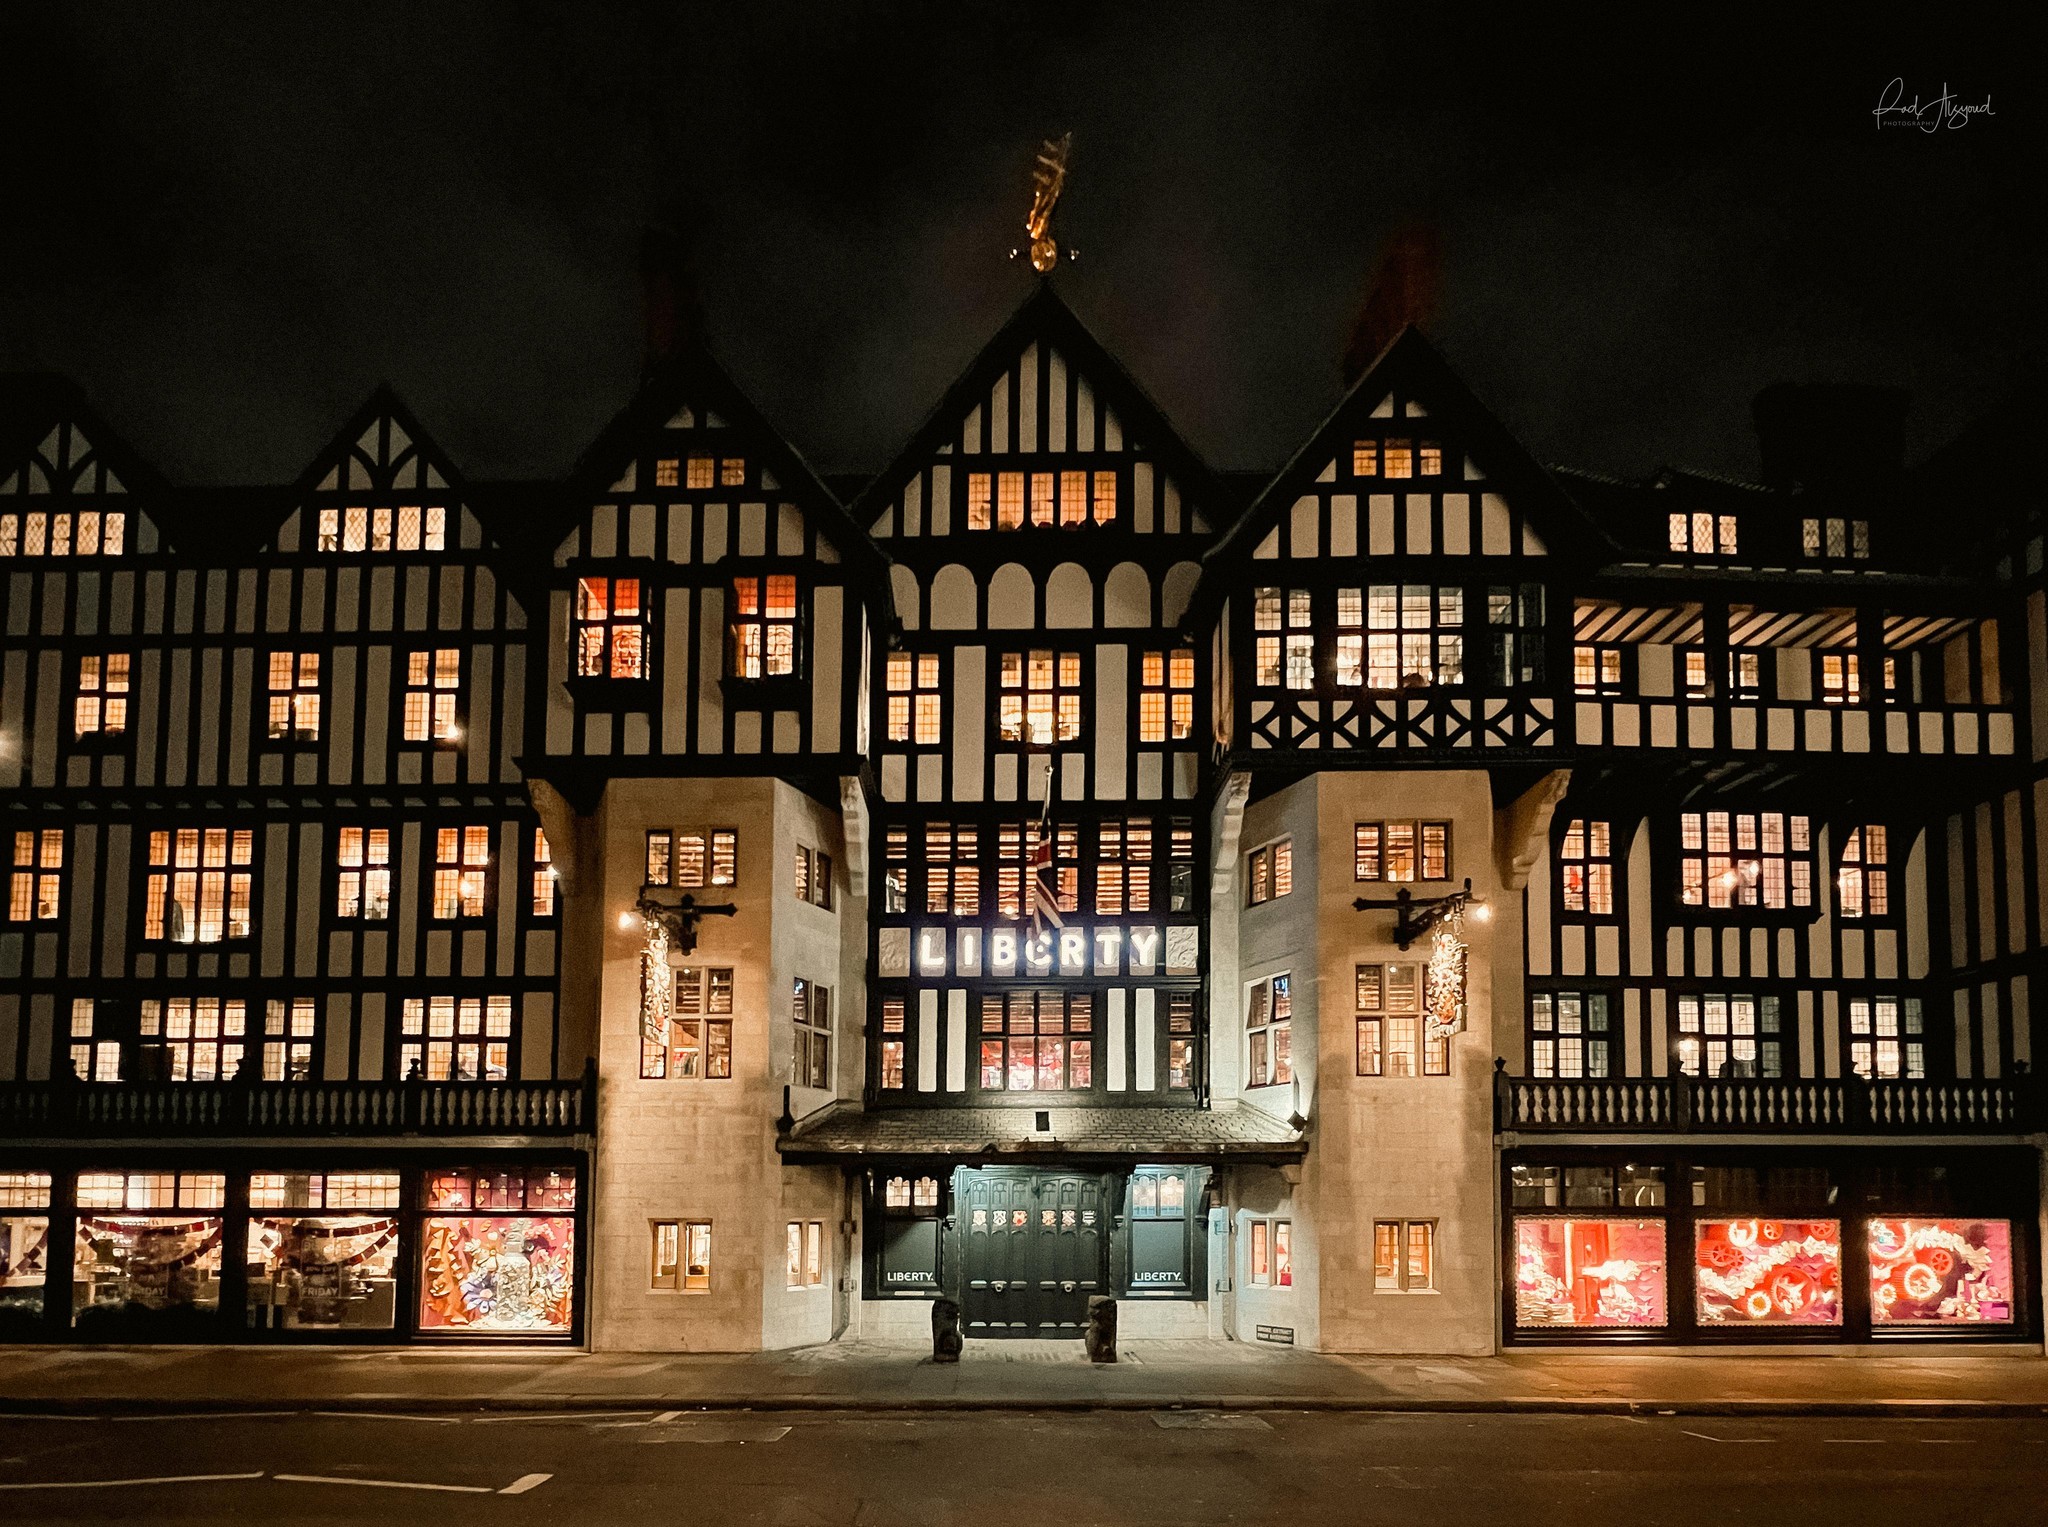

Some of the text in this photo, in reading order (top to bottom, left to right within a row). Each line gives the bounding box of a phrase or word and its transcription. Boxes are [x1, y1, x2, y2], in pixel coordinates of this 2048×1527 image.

[920, 932, 1160, 967] LIBERTY
[887, 1271, 935, 1282] LIBERTY.
[1134, 1271, 1182, 1282] LIBERTY.
[300, 1287, 338, 1297] FRIDAY
